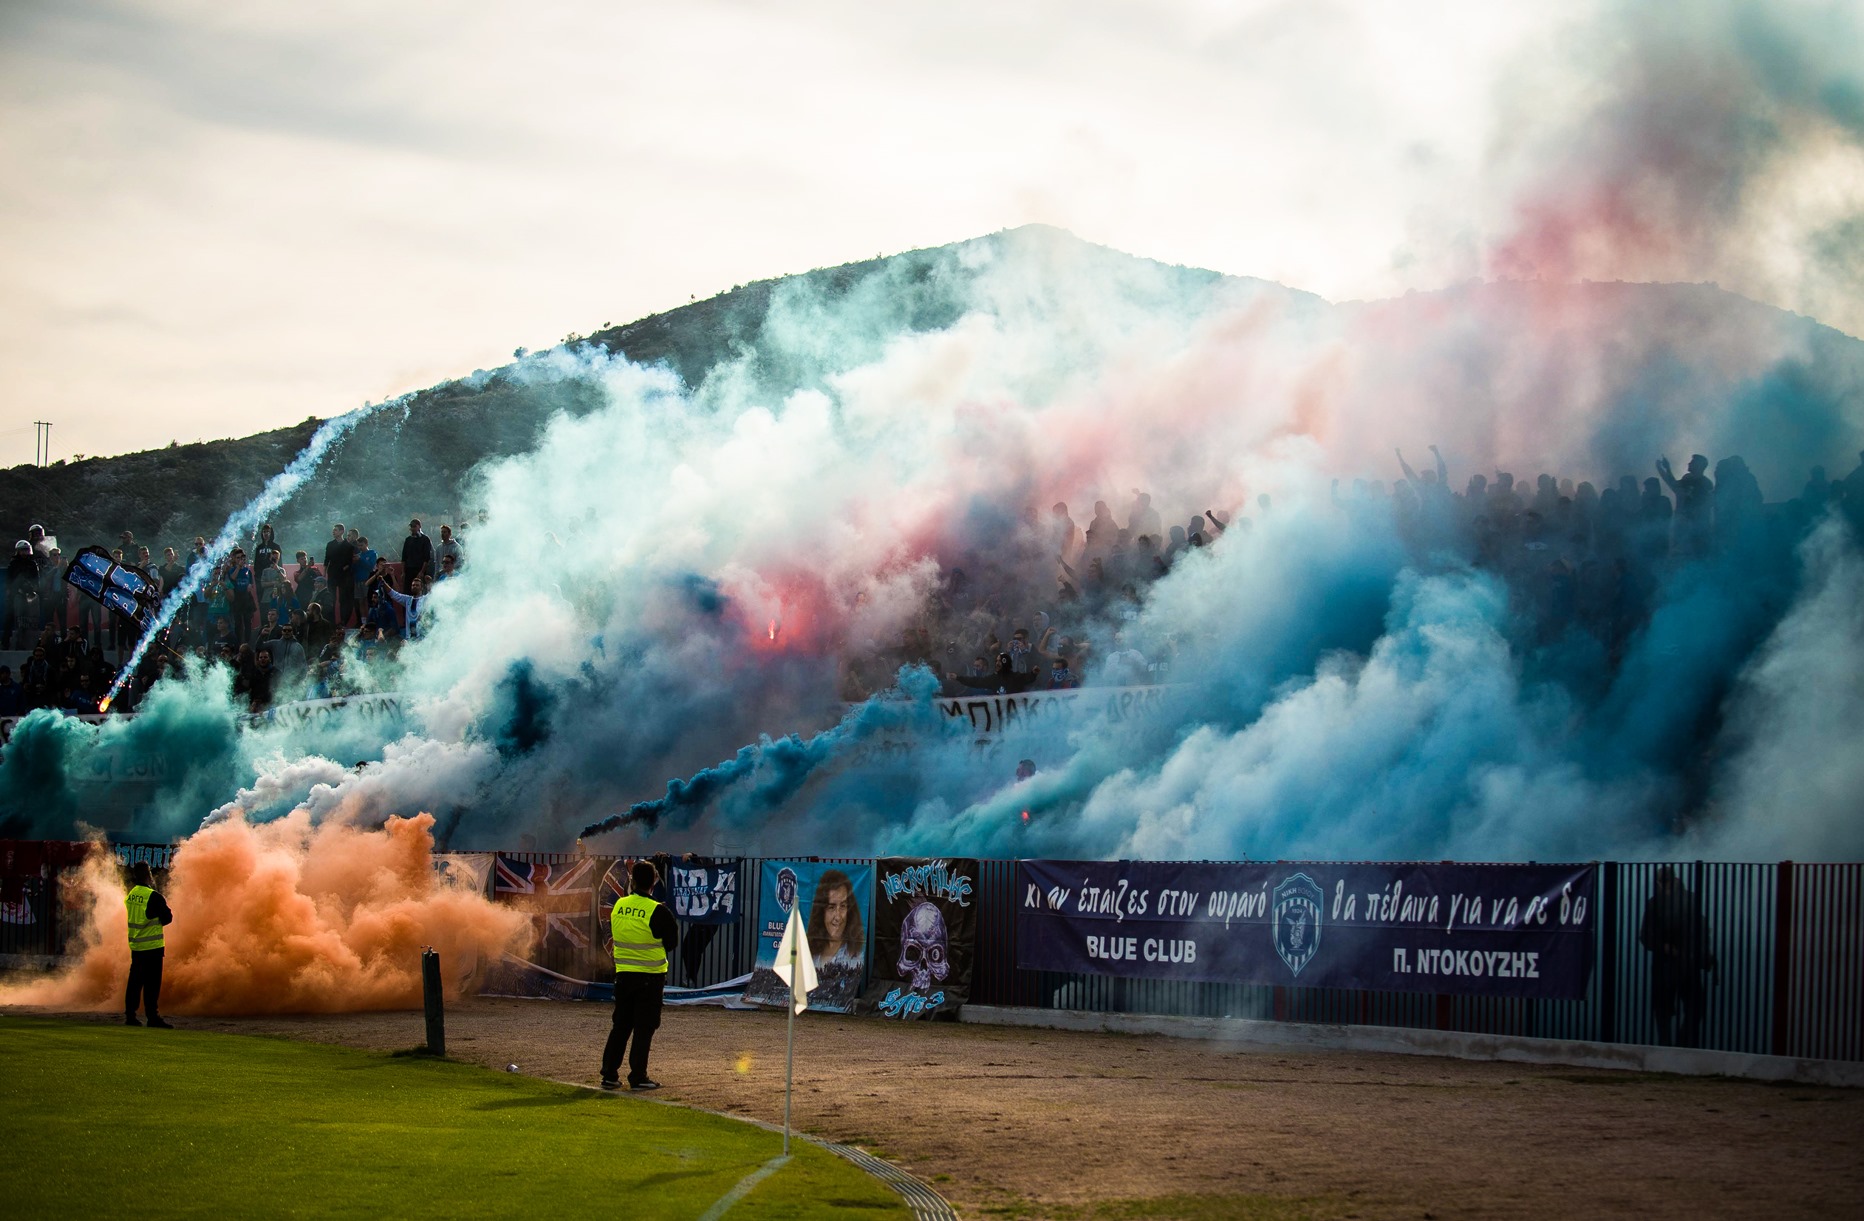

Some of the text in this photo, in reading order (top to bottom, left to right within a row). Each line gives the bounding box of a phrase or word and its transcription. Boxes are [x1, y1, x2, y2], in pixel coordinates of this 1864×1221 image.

[617, 906, 646, 919] ΑΡΓΩ
[1024, 883, 1041, 908] κι
[1047, 885, 1071, 911] αν
[1077, 878, 1150, 923] έπαιζες
[1157, 889, 1200, 917] στον
[1208, 881, 1268, 930] ουρανό
[1331, 879, 1356, 921] θα
[1365, 879, 1440, 923] πέθαινα
[1447, 893, 1483, 935] για
[1560, 881, 1587, 926] δω
[768, 921, 785, 931] BLUE
[1086, 935, 1197, 964] BLUE CLUB
[1393, 947, 1541, 979] Π. ΝΤΟΚΟΥΖΗΣ
